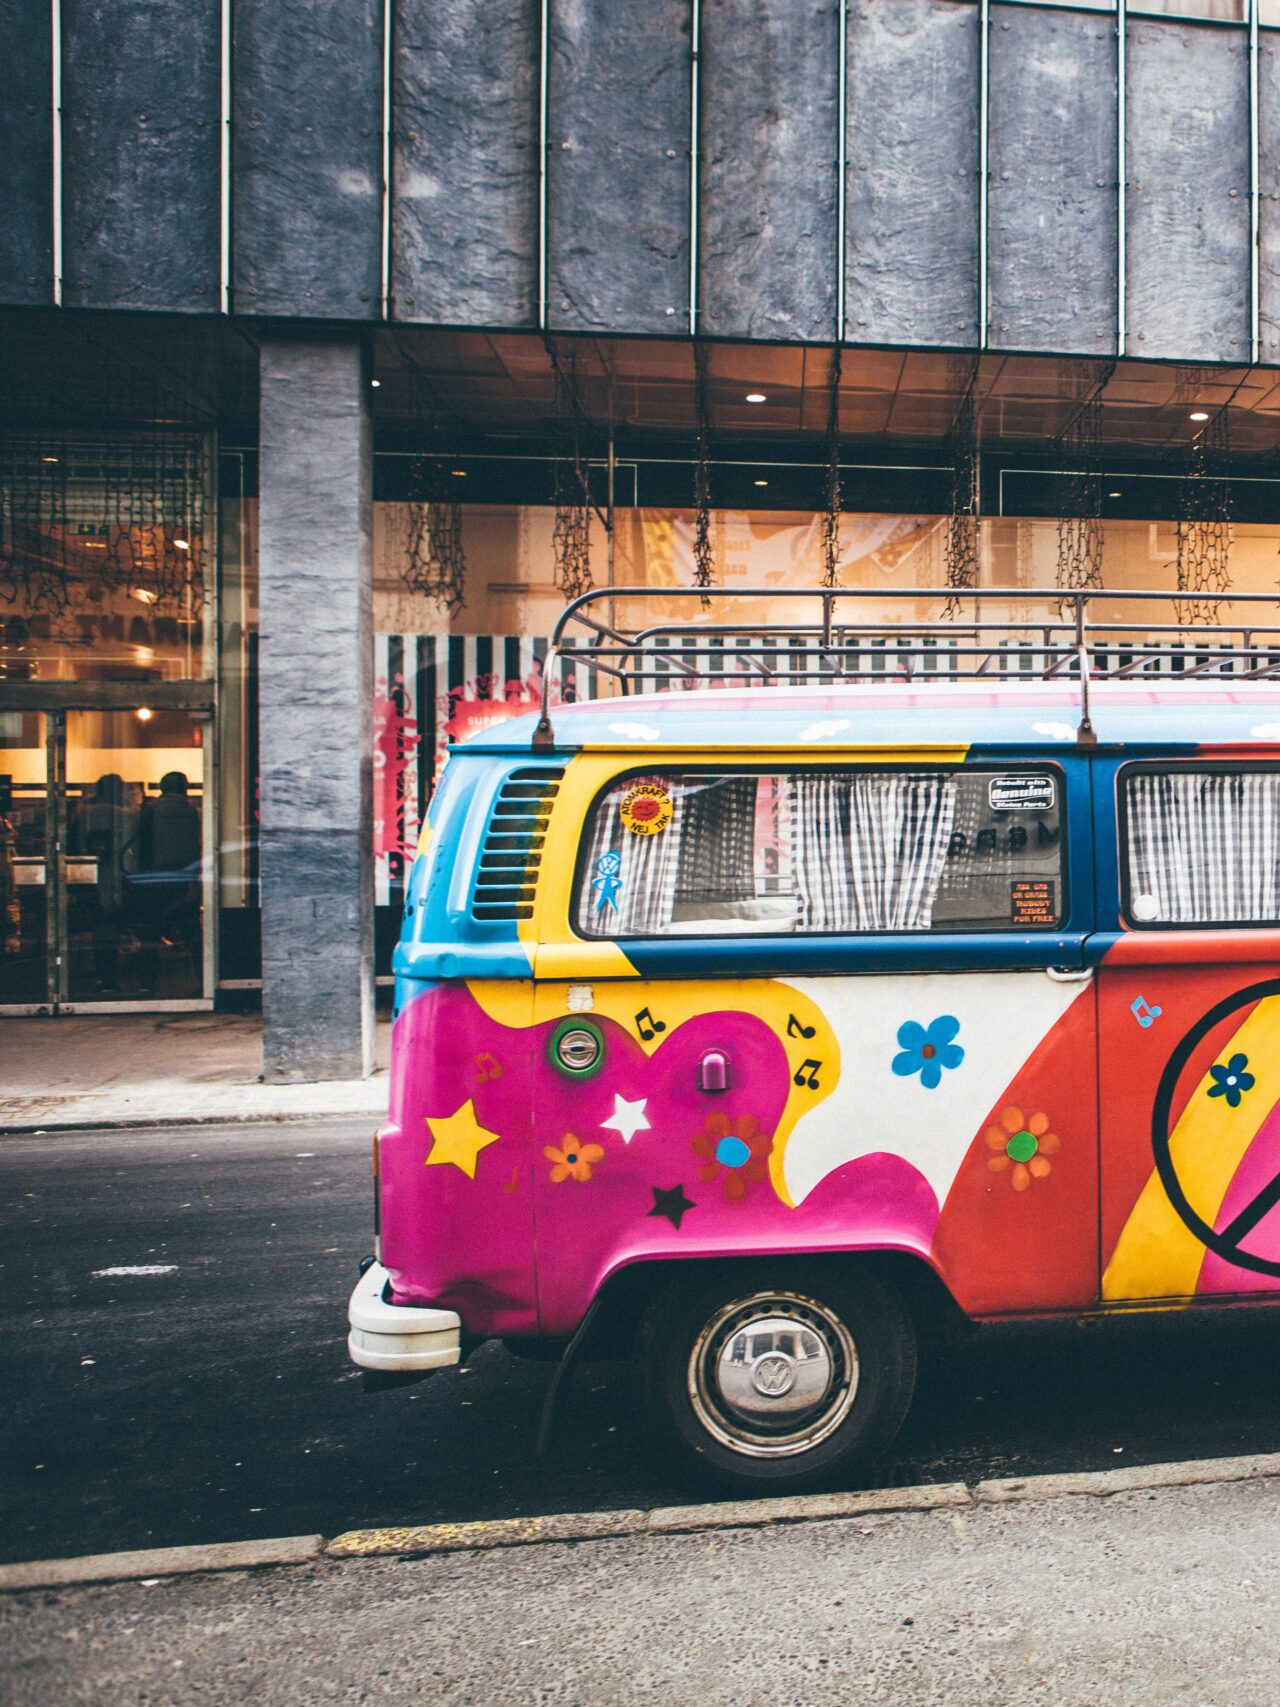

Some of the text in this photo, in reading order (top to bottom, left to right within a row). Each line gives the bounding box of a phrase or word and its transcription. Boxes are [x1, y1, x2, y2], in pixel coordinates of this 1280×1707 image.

[621, 786, 666, 815] ATOMKRAFT
[991, 785, 1052, 799] Genuine
[630, 813, 670, 834] NEJ TAK
[754, 1356, 793, 1391] VW
